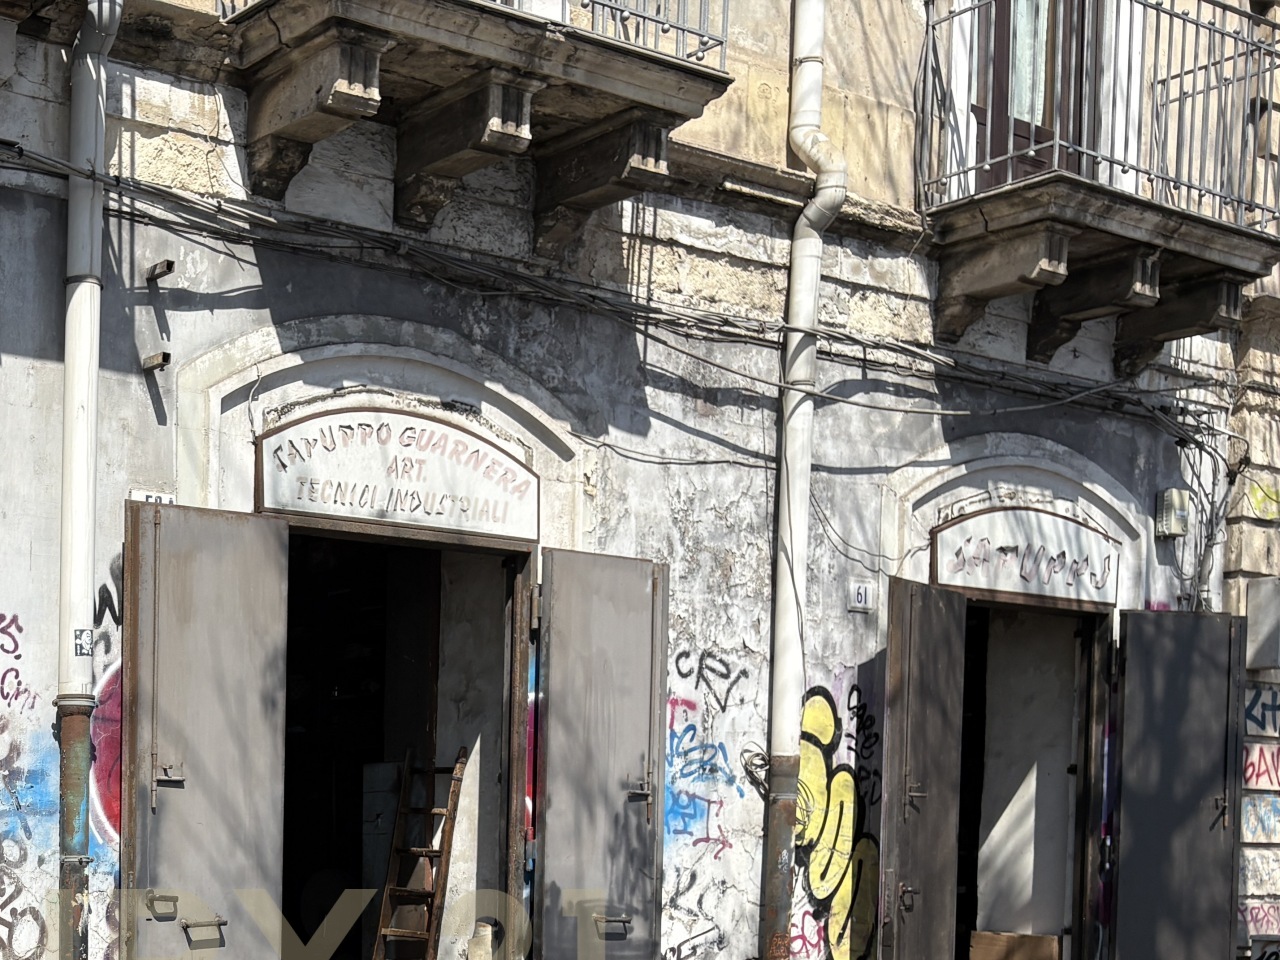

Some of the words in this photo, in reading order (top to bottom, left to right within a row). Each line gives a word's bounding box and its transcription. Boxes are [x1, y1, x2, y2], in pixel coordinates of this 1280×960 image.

[398, 426, 533, 501] GUARNERA
[295, 475, 378, 510] TECNICI
[385, 486, 510, 525] INDUSTRIALI
[856, 585, 867, 605] 61
